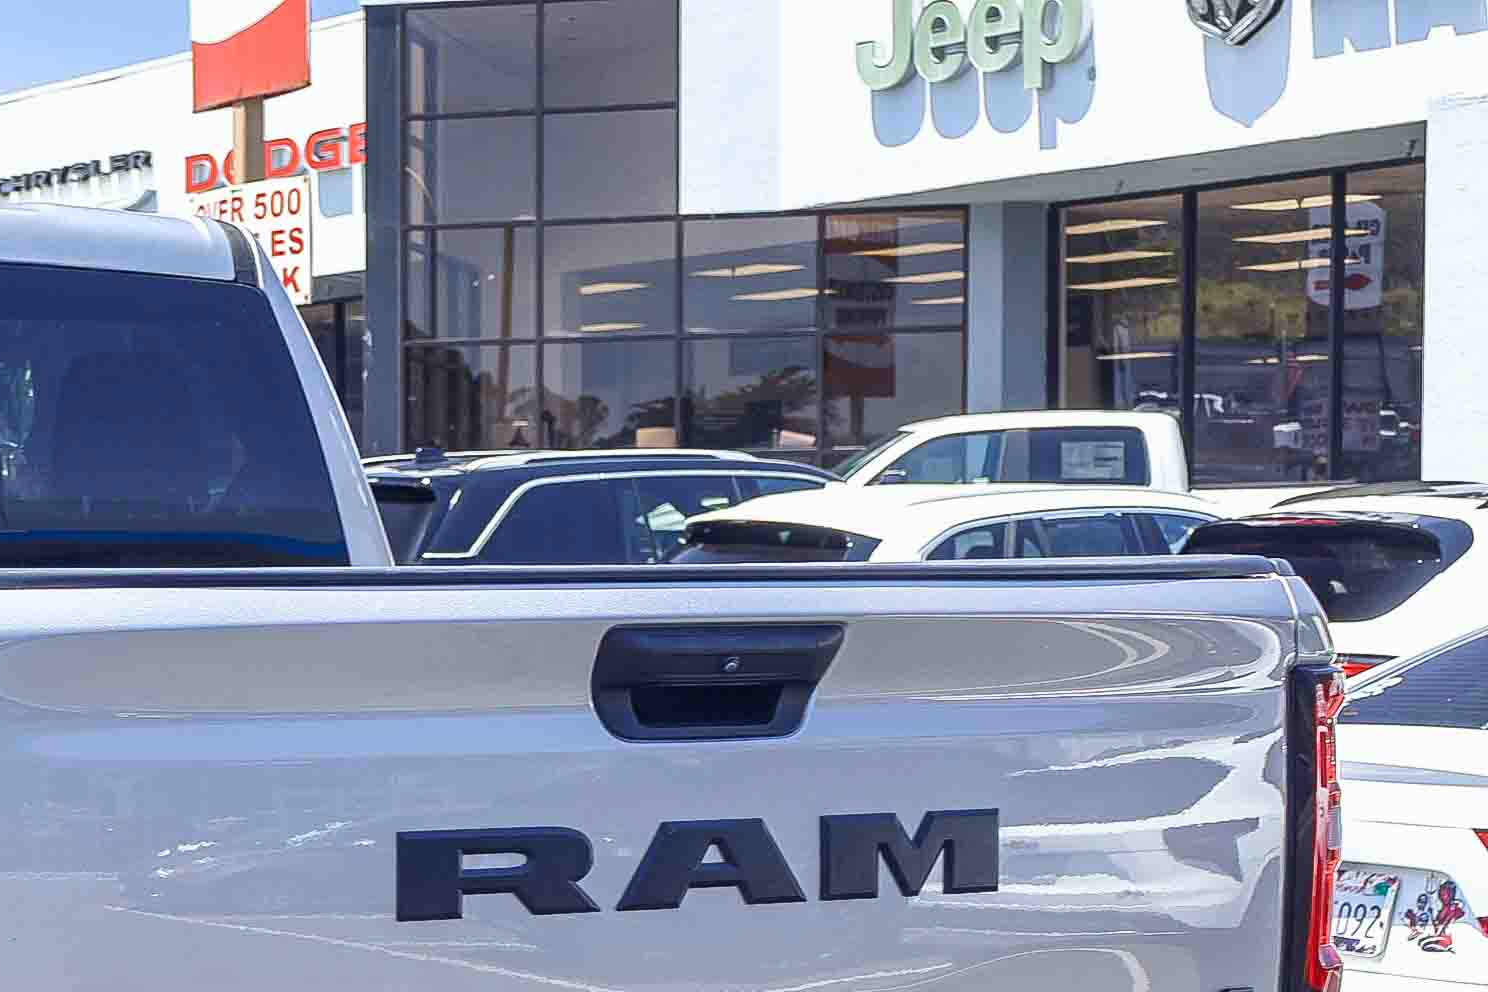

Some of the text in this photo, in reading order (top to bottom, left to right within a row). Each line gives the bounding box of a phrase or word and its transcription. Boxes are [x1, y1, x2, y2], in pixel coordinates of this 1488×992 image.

[855, 0, 1085, 92] Jeep
[254, 187, 302, 220] 500
[270, 226, 305, 257] ES
[396, 808, 1000, 922] RAM
[1334, 900, 1382, 939] 092
